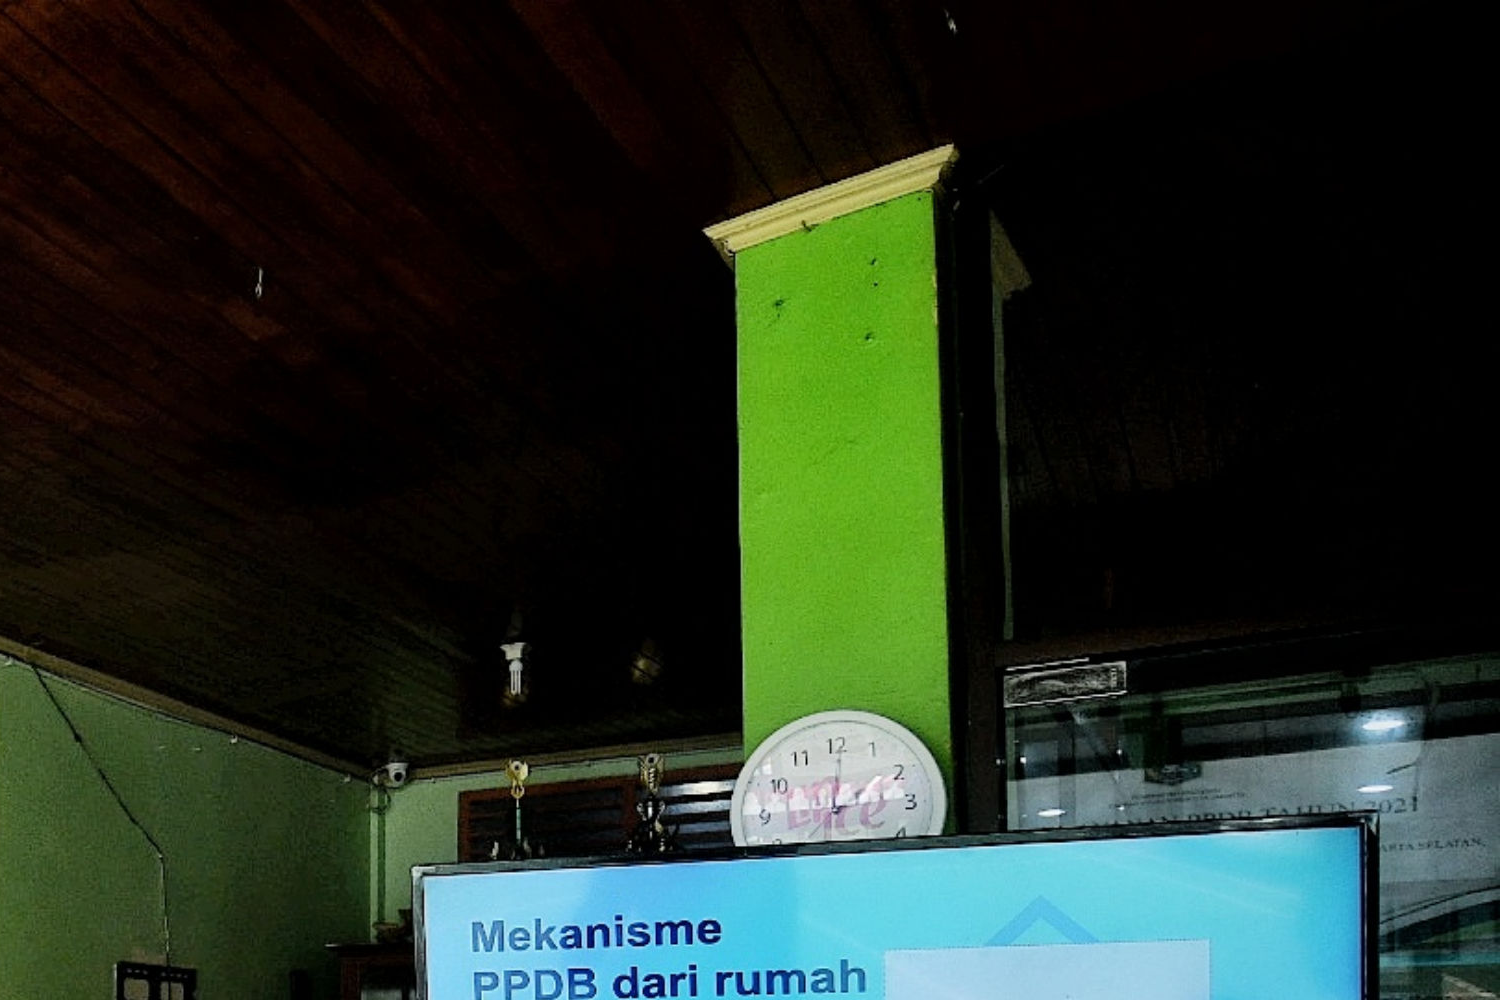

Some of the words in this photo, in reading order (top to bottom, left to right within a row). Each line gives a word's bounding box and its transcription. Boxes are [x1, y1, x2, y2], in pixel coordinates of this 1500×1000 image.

[826, 736, 847, 755] 12
[868, 741, 877, 757] 1
[791, 750, 809, 767] 11
[893, 764, 905, 781] 2
[771, 777, 788, 795] 10
[905, 793, 918, 810] 3
[758, 808, 771, 825] 9
[470, 915, 722, 953] Mekanisme
[611, 964, 698, 1000] dari
[714, 958, 867, 997] rumah
